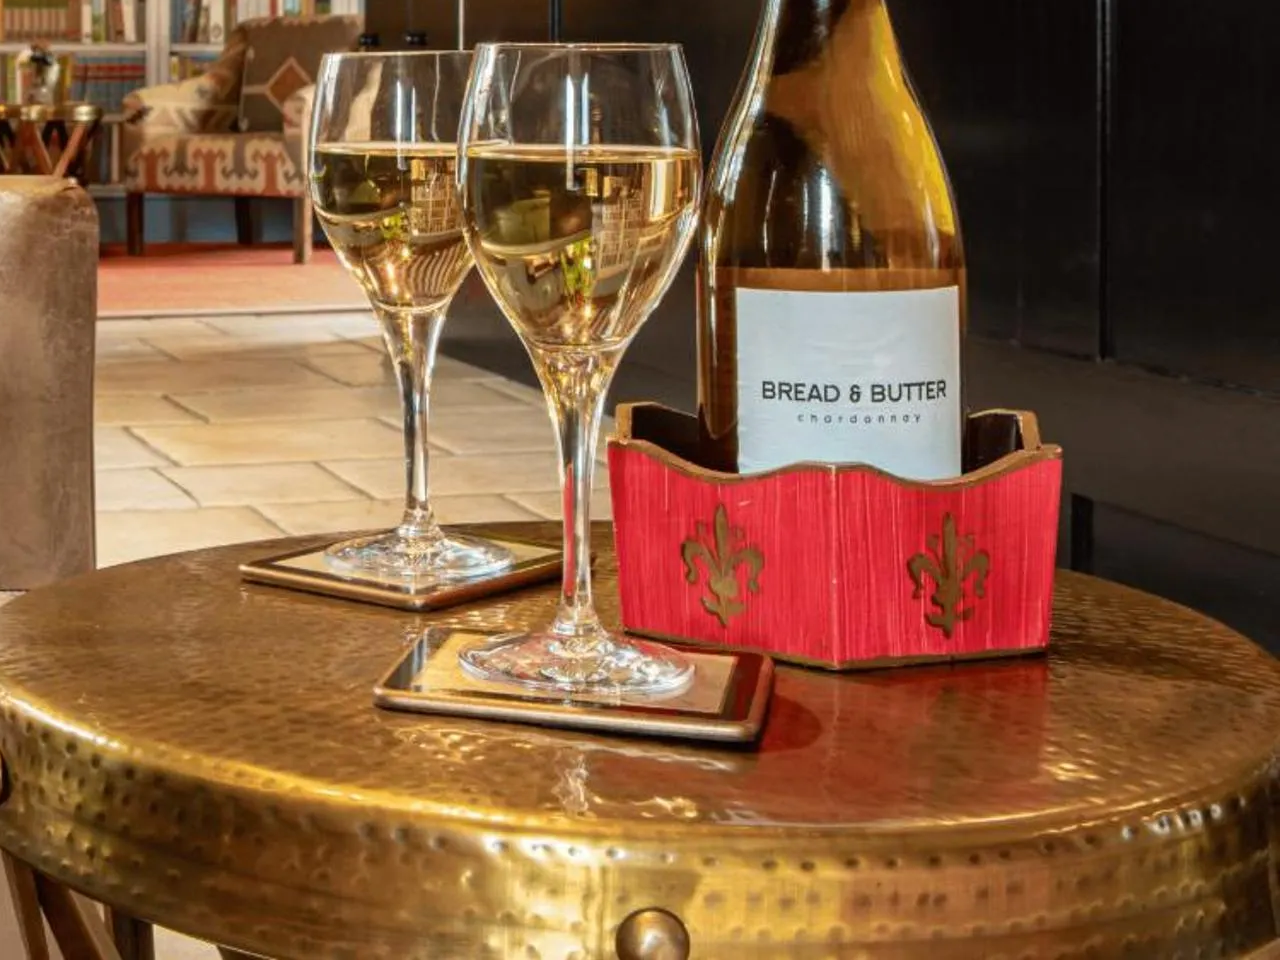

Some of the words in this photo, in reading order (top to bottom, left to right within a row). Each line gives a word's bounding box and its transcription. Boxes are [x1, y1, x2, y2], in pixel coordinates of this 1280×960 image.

[761, 380, 840, 403] BREAD
[849, 384, 861, 403] &
[871, 380, 946, 403] BUTTER
[797, 413, 921, 424] chardonnay
